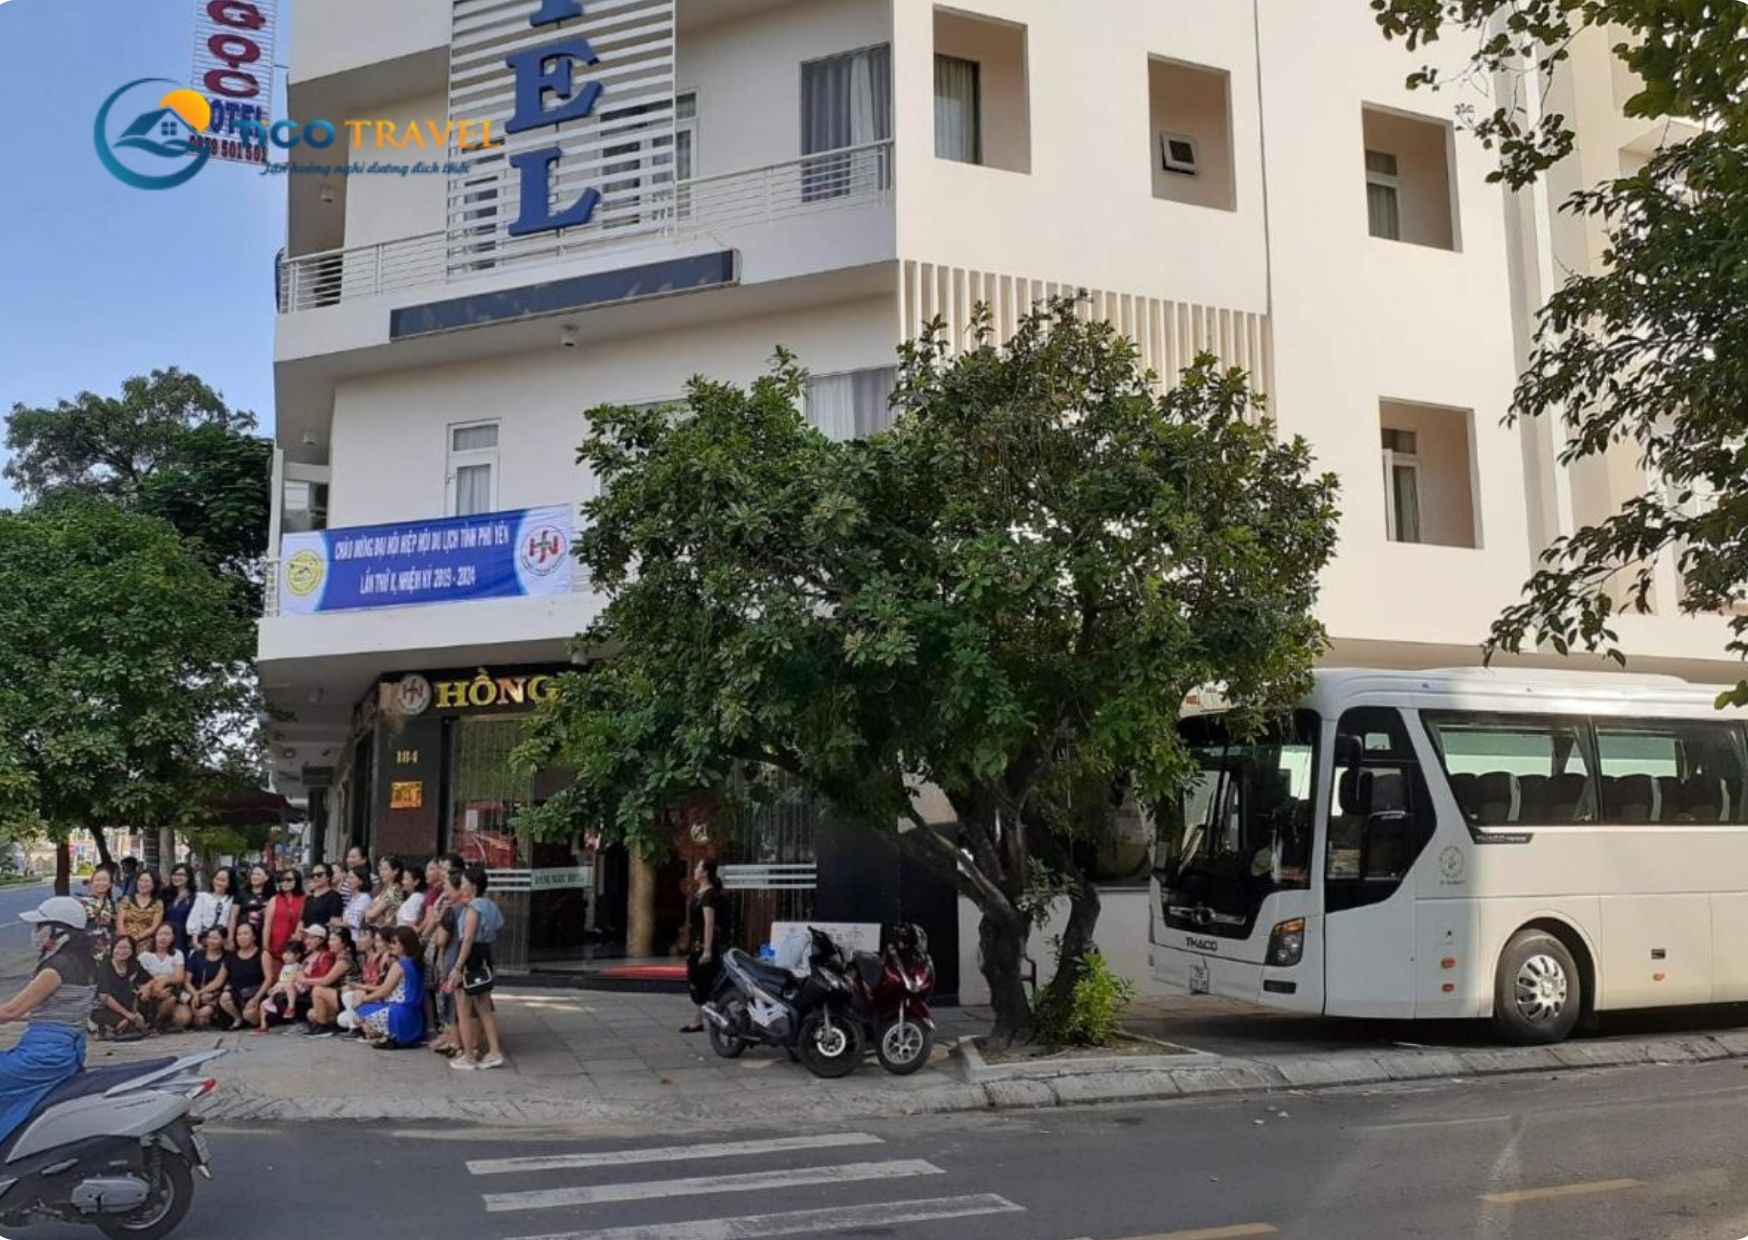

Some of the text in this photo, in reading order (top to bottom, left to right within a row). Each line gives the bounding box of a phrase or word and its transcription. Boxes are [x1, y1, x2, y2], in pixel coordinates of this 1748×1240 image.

[203, 98, 265, 139] OTEL
[506, 0, 604, 238] EL
[435, 666, 561, 708] HỒNG
